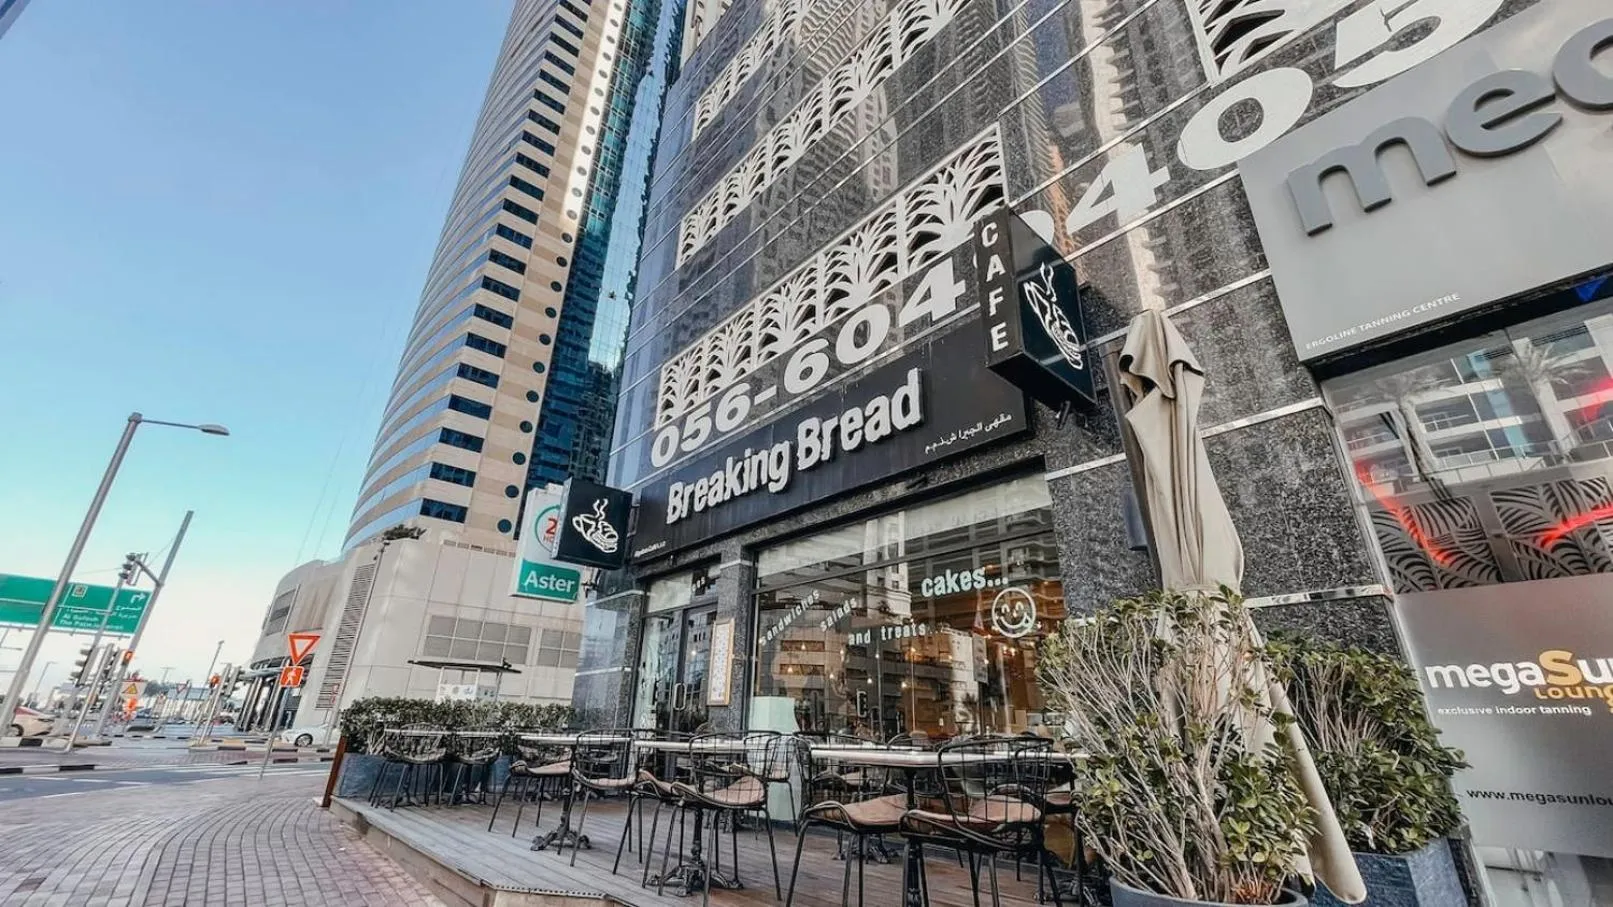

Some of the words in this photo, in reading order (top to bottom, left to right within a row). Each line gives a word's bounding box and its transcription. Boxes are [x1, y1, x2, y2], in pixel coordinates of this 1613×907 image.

[981, 222, 1009, 352] CAFE
[1305, 327, 1357, 350] ERGOLINE
[1358, 309, 1411, 332] TANNING
[1412, 292, 1461, 313] CENTRE
[666, 440, 790, 525] Breaking
[797, 368, 922, 471] Bread
[524, 571, 576, 593] Aster
[759, 589, 820, 646] sandwiches
[820, 597, 858, 632] salads
[848, 630, 872, 646] and
[1437, 704, 1493, 715] exclusive
[1495, 703, 1536, 715] indoor
[1540, 704, 1592, 716] tanning
